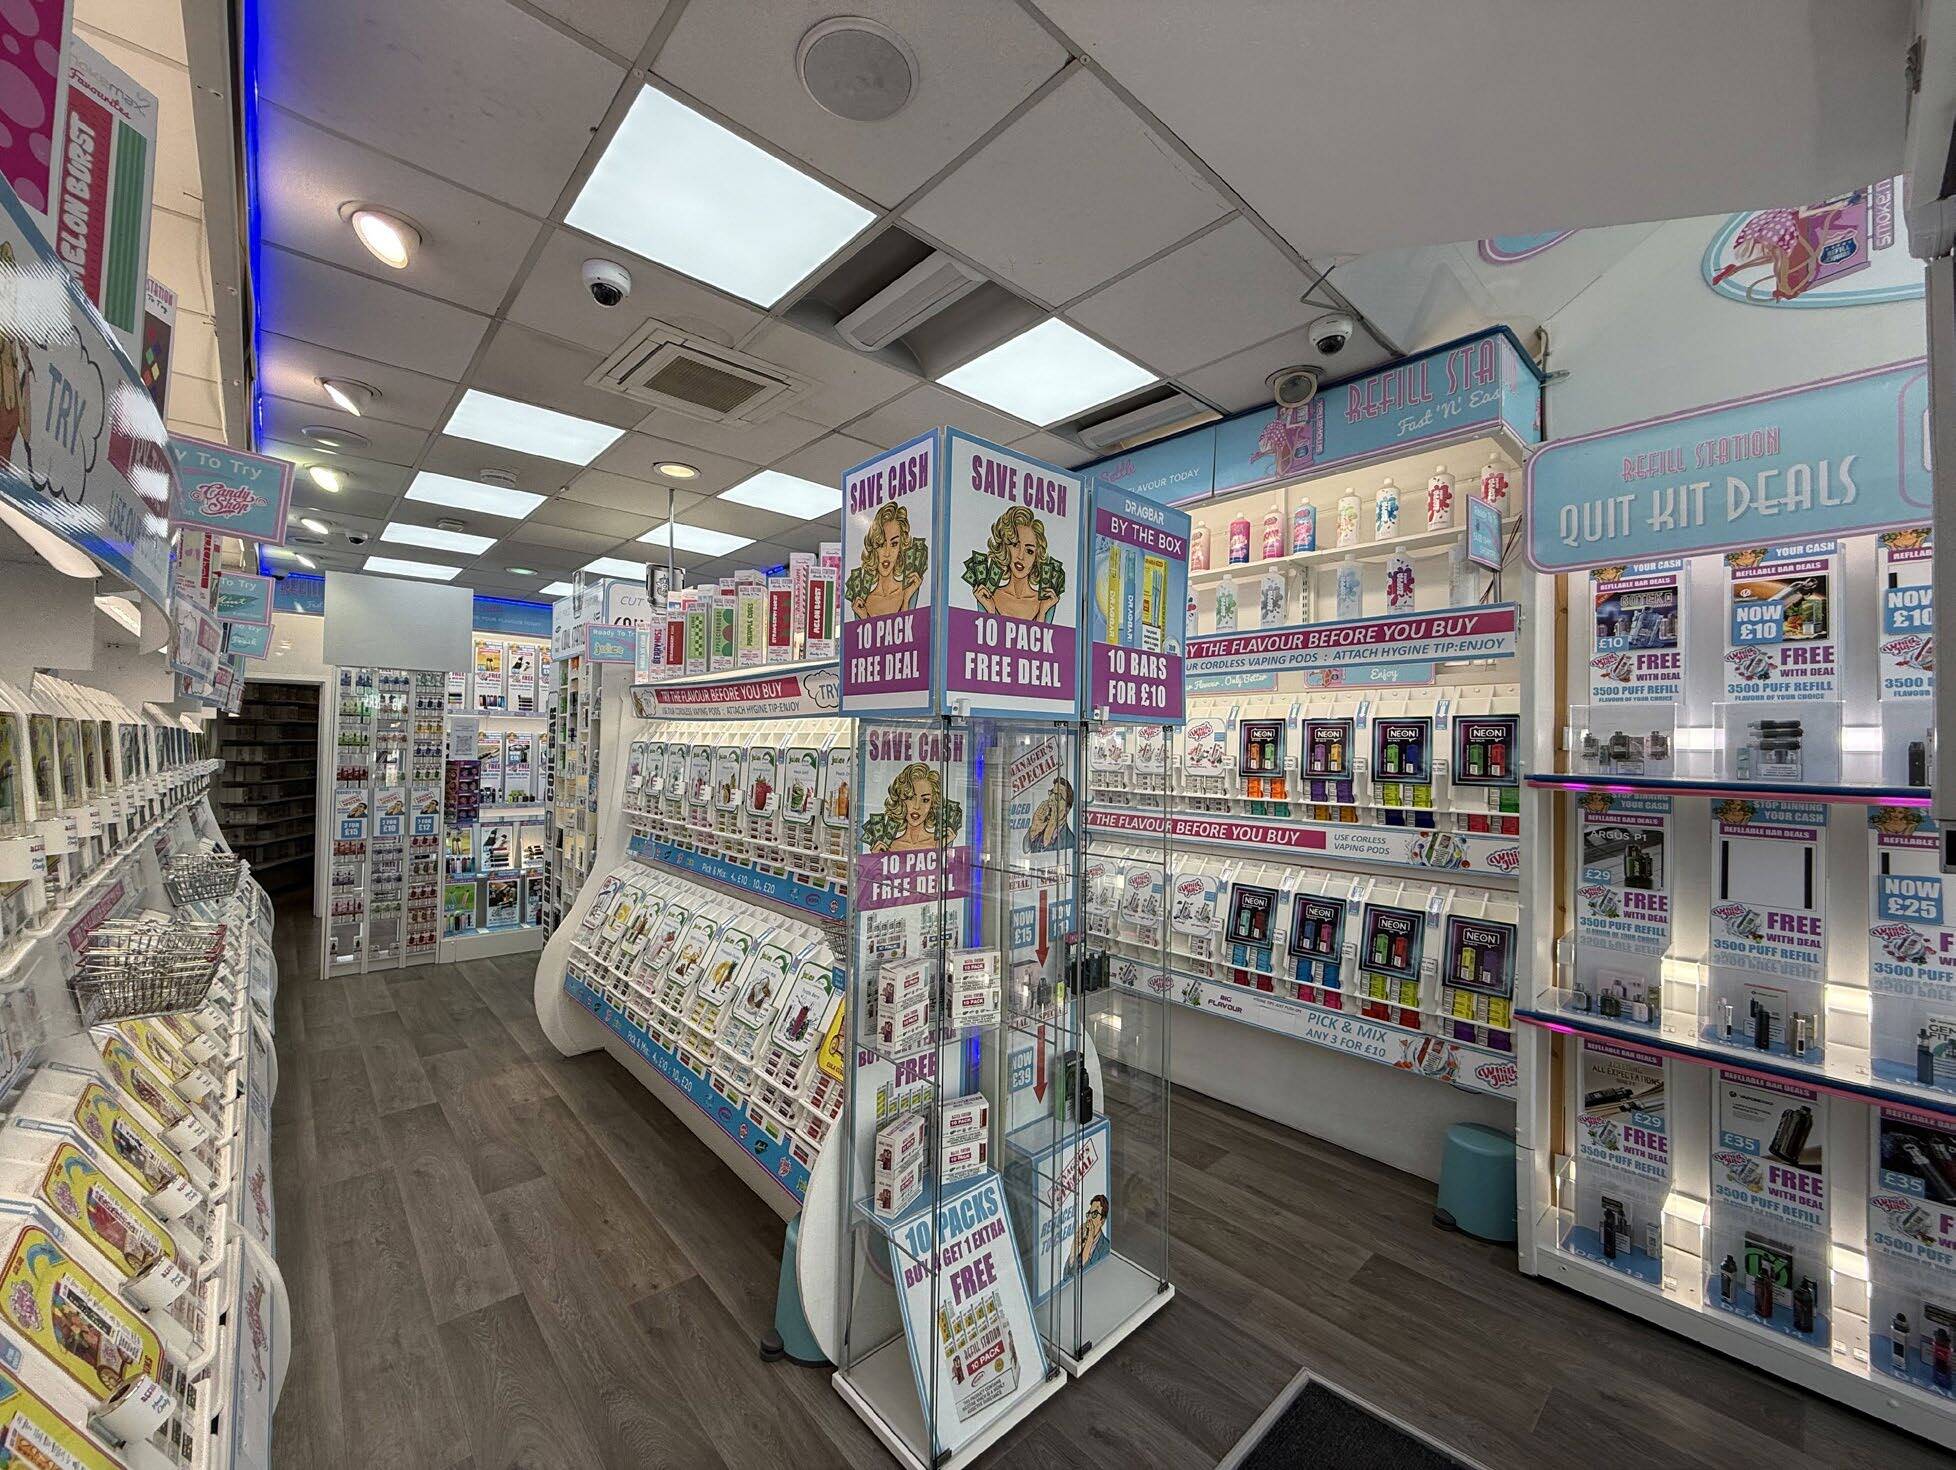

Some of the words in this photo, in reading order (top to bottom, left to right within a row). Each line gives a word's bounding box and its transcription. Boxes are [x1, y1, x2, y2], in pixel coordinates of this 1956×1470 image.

[69, 67, 132, 120] Favourites
[65, 111, 96, 200] BURST
[1344, 361, 1433, 424] REFILL
[45, 362, 87, 455] TRY
[1397, 415, 1434, 437] Fast
[1621, 447, 1686, 482] REFILL
[1695, 427, 1781, 469] STATION
[196, 451, 221, 469] To
[229, 459, 263, 480] Try
[1169, 468, 1200, 482] TODAY
[200, 483, 253, 503] Candy
[850, 468, 883, 515] SAVE
[888, 450, 929, 498] CASH
[971, 453, 1017, 503] SAVE
[1023, 472, 1068, 518] CASH
[204, 497, 251, 516] Shop
[1560, 493, 1636, 548] QUIT
[1646, 481, 1711, 532] KIT
[1727, 454, 1857, 523] DEALS
[1124, 499, 1164, 526] DRAGBAR
[1111, 517, 1128, 537] BY
[1132, 524, 1155, 546] THE
[1158, 532, 1182, 555] BOX
[1776, 546, 1804, 557] YOUR
[1805, 542, 1835, 553] CASH
[1777, 565, 1795, 573] BAR
[1796, 562, 1821, 571] DEALS
[238, 578, 257, 591] Try
[620, 596, 645, 606] CUT
[1126, 594, 1134, 642] DRAGBAR
[1736, 605, 1782, 622] NOW
[856, 625, 875, 649] 10
[876, 614, 914, 645] PACK
[974, 617, 997, 644] 10
[1005, 624, 1054, 654] PACK
[1201, 641, 1228, 657] THE
[1231, 634, 1303, 654] FLAVOUR
[1308, 627, 1378, 648] BEFORE
[1383, 622, 1426, 641] YOU
[1431, 616, 1478, 637] BUY
[1740, 622, 1777, 640] £10
[1599, 637, 1623, 648] £10
[1108, 649, 1126, 673] 10
[1130, 652, 1167, 679] BARS
[1200, 658, 1245, 671] CORDLESS
[1248, 654, 1286, 667] VAPING
[1289, 652, 1318, 664] PODS
[1333, 648, 1378, 661] ATTACH
[1380, 644, 1429, 657] HYGINE
[1780, 645, 1835, 666] FREE
[850, 656, 883, 684] FREE
[885, 651, 919, 681] DEAL
[965, 651, 1014, 685] FREE
[1019, 657, 1061, 688] DEAL
[1370, 668, 1399, 681] Enjoy
[1780, 668, 1807, 677] WITH
[1810, 667, 1835, 677] DEAL
[681, 688, 711, 702] FLAVOUR
[710, 685, 740, 700] BEFORE
[740, 684, 759, 698] YOU
[759, 681, 782, 697] BUY
[1108, 680, 1137, 705] FOR
[1140, 683, 1166, 708] £10
[1728, 683, 1760, 694] 3500
[1762, 682, 1792, 693] PUFF
[1793, 681, 1833, 692] REFILL
[726, 704, 746, 715] ATTACH
[1390, 729, 1416, 738] NEON
[1472, 728, 1503, 738] NEON
[868, 729, 915, 763] SAVE
[1011, 752, 1060, 793] SPECIAL
[1096, 814, 1116, 827] THE
[1118, 816, 1173, 833] FLAVOUR
[1176, 822, 1228, 838] BEFORE
[1232, 827, 1263, 842] YOU
[1266, 829, 1300, 845] BUY
[1334, 833, 1350, 842] USE
[1350, 834, 1386, 845] CORLESS
[1589, 830, 1630, 841] ARGUS
[1634, 832, 1648, 842] P1
[1334, 843, 1365, 853] VAPING
[1367, 845, 1390, 855] PODS
[881, 856, 900, 875] 10
[1585, 869, 1611, 880] £29
[737, 874, 748, 885] £10
[763, 883, 776, 894] £20
[872, 876, 911, 901] FREE
[1884, 877, 1940, 899] NOW
[1887, 897, 1937, 918] £25
[1013, 910, 1035, 927] NOW
[1381, 919, 1408, 931] NEON
[1766, 912, 1822, 937] FREE
[1014, 927, 1033, 943] £15
[1465, 931, 1497, 944] NEON
[1208, 999, 1243, 1014] FLAVOUR
[1219, 994, 1232, 1003] BIG
[1308, 1012, 1337, 1030] PICK
[1343, 1021, 1352, 1034] &
[1357, 1025, 1387, 1043] MIX
[1306, 1028, 1329, 1041] ANY
[1330, 1033, 1338, 1044] 3
[1340, 1037, 1363, 1051] FOR
[1364, 1044, 1386, 1057] £10
[894, 1051, 936, 1089] FREE
[1012, 1068, 1032, 1086] £39
[681, 1076, 693, 1092] £20
[1634, 1113, 1661, 1128] £29
[1580, 1143, 1607, 1160] 3500
[1723, 1134, 1755, 1150] £35
[1768, 1165, 1824, 1199] FREE
[904, 1220, 931, 1258] 10
[940, 1186, 999, 1243] PACKS
[904, 1261, 929, 1289] BUY
[942, 1242, 963, 1267] GET
[964, 1237, 973, 1254] 1
[971, 1217, 1006, 1250] EXTRA
[950, 1251, 998, 1306] FREE
[970, 1362, 979, 1370] 10
[979, 1345, 1001, 1366] PACK
